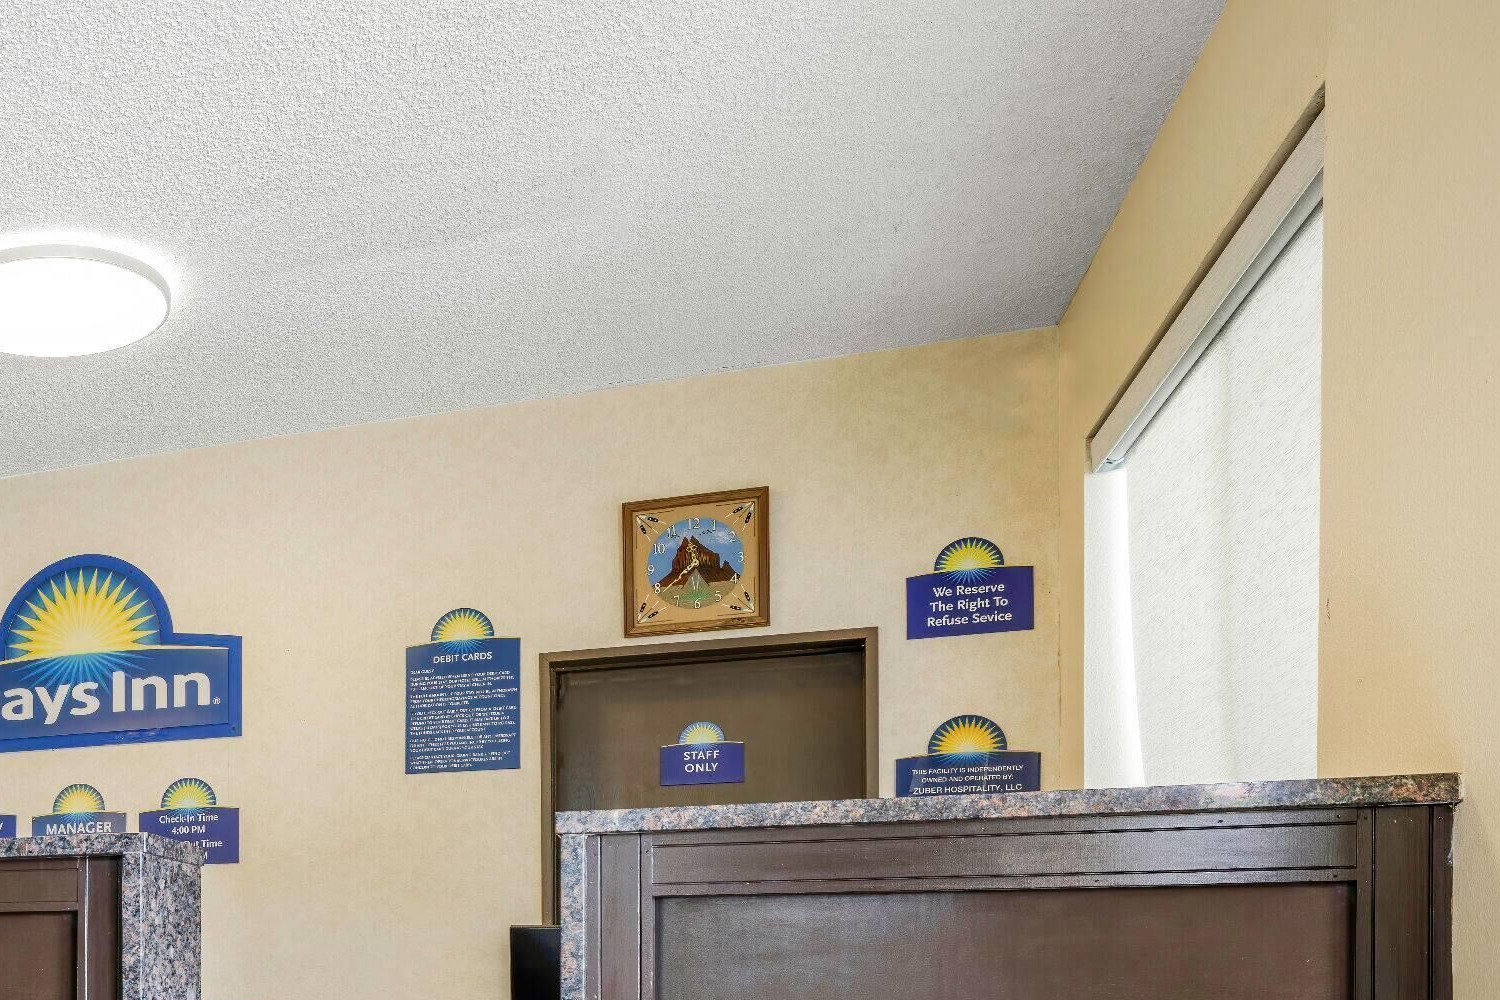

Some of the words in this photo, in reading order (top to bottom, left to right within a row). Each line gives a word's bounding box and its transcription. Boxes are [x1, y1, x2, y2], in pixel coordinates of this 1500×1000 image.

[687, 517, 700, 529] 12
[729, 531, 736, 543] 2
[653, 543, 666, 555] 10
[737, 551, 744, 563] 3
[647, 564, 655, 576] 9
[730, 573, 739, 584] 4
[654, 582, 661, 594] 8
[932, 587, 953, 597] We
[956, 583, 1005, 595] Reserve
[673, 595, 680, 607] 7
[715, 591, 723, 602] 5
[694, 598, 701, 609] 6
[930, 601, 954, 612] The
[957, 598, 990, 611] Right
[993, 596, 1009, 607] To
[927, 615, 969, 627] Refuse
[972, 611, 1013, 623] Sevice
[433, 654, 459, 664] DEBIT
[461, 651, 493, 662] CARDS
[112, 670, 211, 713] Inn
[683, 750, 720, 761] STAFF
[684, 762, 719, 773] ONLY
[967, 764, 1025, 773] INDEPENDENTLY
[912, 786, 943, 795] ZUBER
[944, 784, 1003, 793] HOSPITALITY,
[1005, 783, 1023, 791] LLC
[158, 814, 195, 824] Check-In
[197, 813, 219, 822] Time
[46, 821, 112, 835] MANAGER
[171, 826, 190, 835] 4:00
[191, 824, 206, 834] PM
[201, 839, 223, 848] Time
